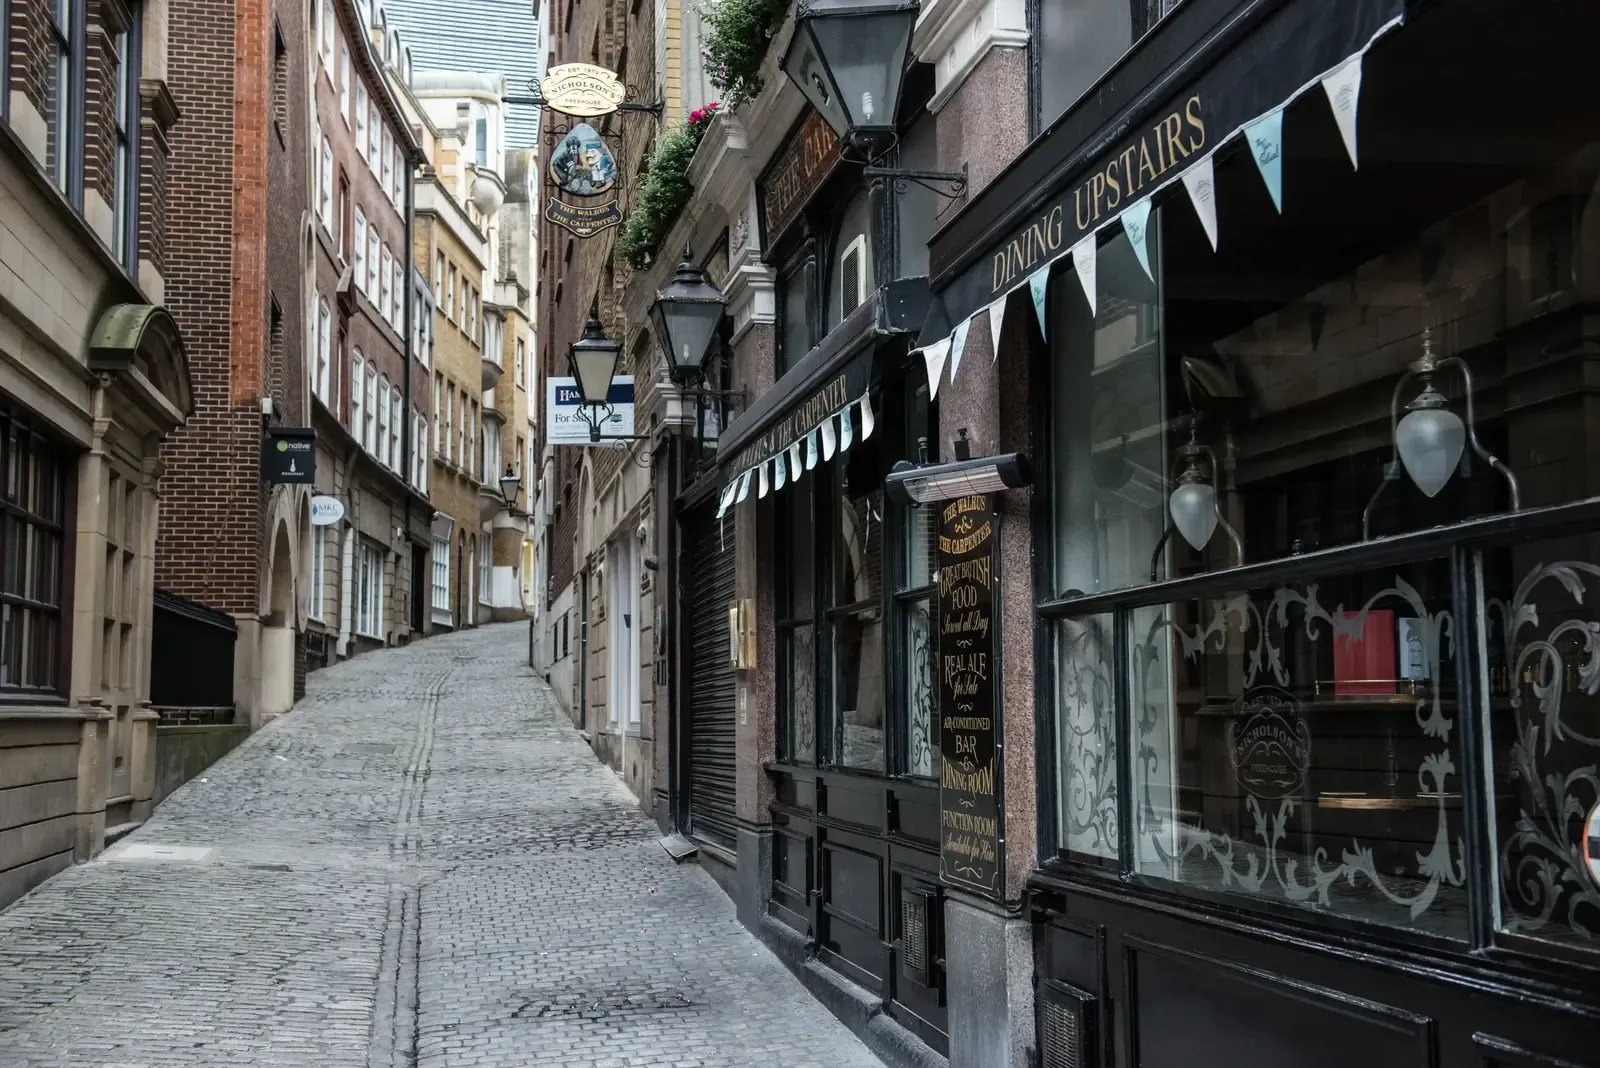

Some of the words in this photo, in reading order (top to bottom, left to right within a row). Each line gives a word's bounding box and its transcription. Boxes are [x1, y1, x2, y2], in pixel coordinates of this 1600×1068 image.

[551, 81, 616, 99] NICHOLSON'S
[777, 154, 801, 215] THE
[991, 205, 1063, 293] DINING
[1074, 93, 1206, 230] UPSTAIRS
[552, 212, 569, 223] THE
[560, 204, 576, 214] THE
[555, 414, 569, 423] For
[778, 415, 793, 450] THE
[795, 374, 848, 435] CARPENTER
[319, 503, 338, 512] MKC
[943, 501, 957, 524] THE
[957, 495, 986, 514] WALRUS
[939, 535, 951, 553] THE
[952, 520, 991, 554] CARPENTER
[940, 564, 961, 598] GREAT
[962, 555, 990, 591] BRITISH
[952, 584, 978, 610] FOOD
[972, 609, 989, 639] Day
[944, 654, 966, 690] REAL
[968, 652, 987, 681] ALE
[953, 674, 964, 700] for
[963, 673, 979, 695] Sale
[943, 716, 991, 733] AIR-CONDITIONED
[955, 734, 979, 764] BAR
[1237, 725, 1300, 758] NICHOLSON'S
[941, 753, 967, 791] DINING
[968, 756, 994, 800] ROOM
[942, 809, 974, 832] FUNCTION
[974, 816, 995, 839] ROOM
[980, 839, 995, 862] Hire
